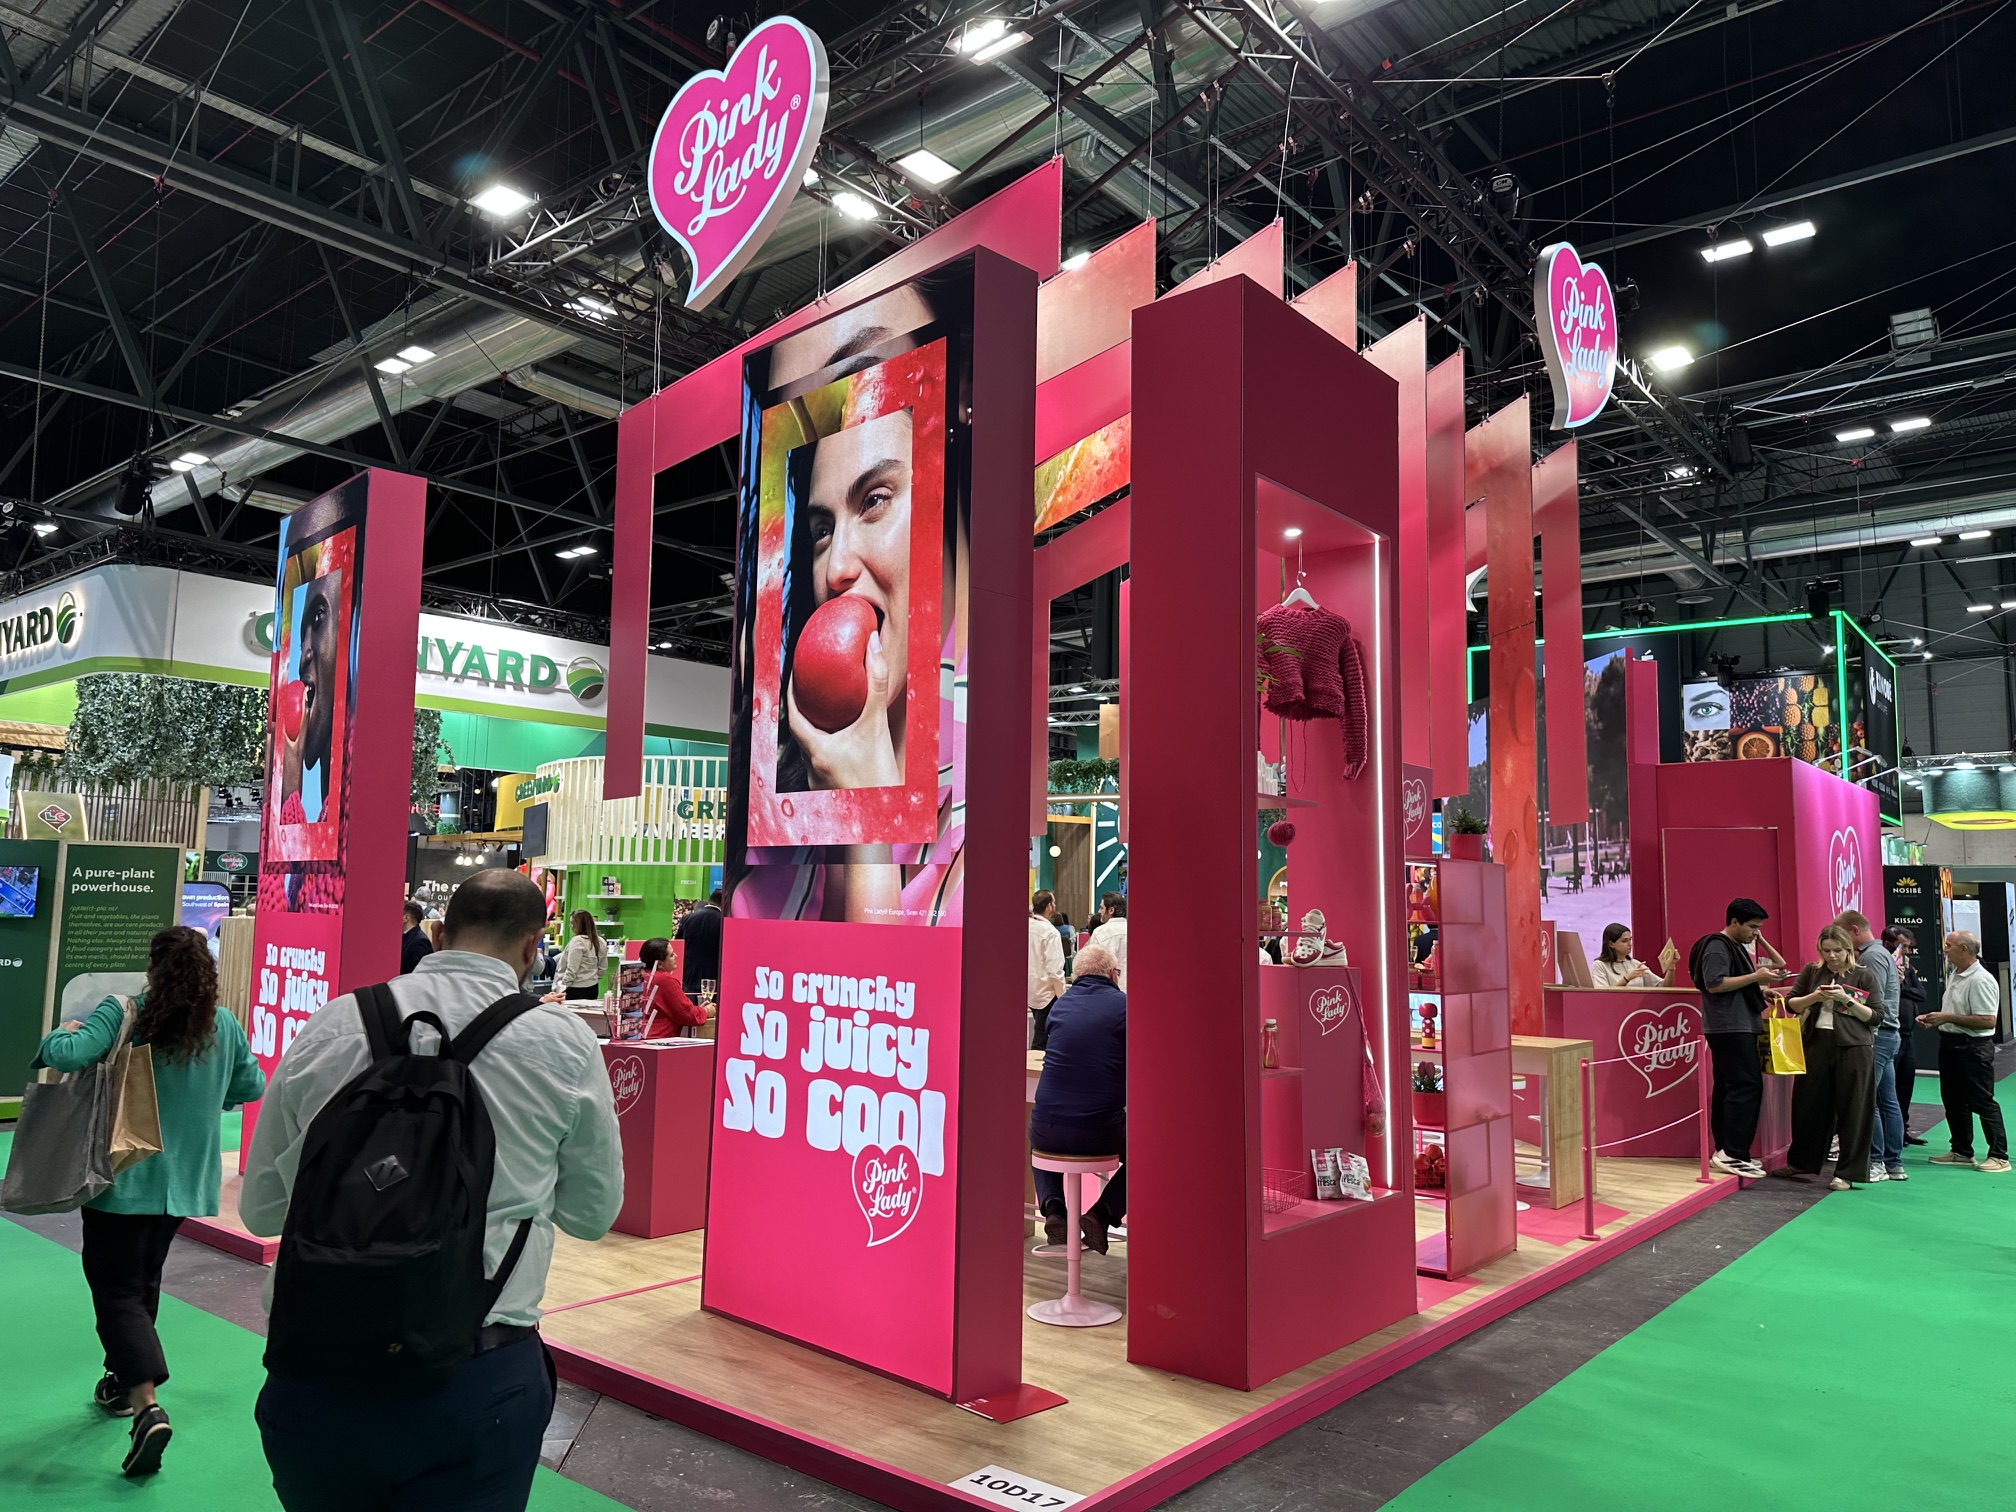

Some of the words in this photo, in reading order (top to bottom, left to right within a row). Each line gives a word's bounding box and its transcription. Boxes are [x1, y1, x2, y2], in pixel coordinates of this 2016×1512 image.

[674, 43, 781, 195] Pink
[1560, 276, 1606, 335] Pink
[1404, 784, 1422, 811] Pink
[71, 881, 154, 894] powerhouse.
[72, 866, 83, 878] A
[85, 867, 156, 880] pure-plant
[423, 880, 449, 893] The
[1835, 841, 1857, 908] Pink
[196, 893, 230, 902] production
[1892, 886, 1922, 894] NOSIBÉ
[64, 961, 85, 969] centre
[92, 961, 109, 969] every
[70, 945, 86, 953] food
[86, 945, 113, 953] category
[266, 943, 277, 966] So
[280, 946, 325, 976] crunchy
[259, 968, 279, 1006] So
[281, 968, 329, 1014] juicy
[755, 966, 784, 1000] So
[792, 972, 916, 1019] crunchy
[1316, 989, 1343, 1013] Pink
[1321, 1002, 1345, 1023] Lady
[251, 1005, 277, 1058] So
[740, 1002, 788, 1060] So
[800, 1005, 930, 1090] juicy
[1633, 1011, 1691, 1054] Pink
[1644, 1036, 1695, 1073] Lady
[613, 1061, 639, 1089] Pink
[616, 1080, 641, 1101] Lady
[723, 1057, 787, 1138] So
[806, 1079, 946, 1177] cool
[862, 1152, 909, 1194] Pink
[969, 1473, 1067, 1508] 10D17
